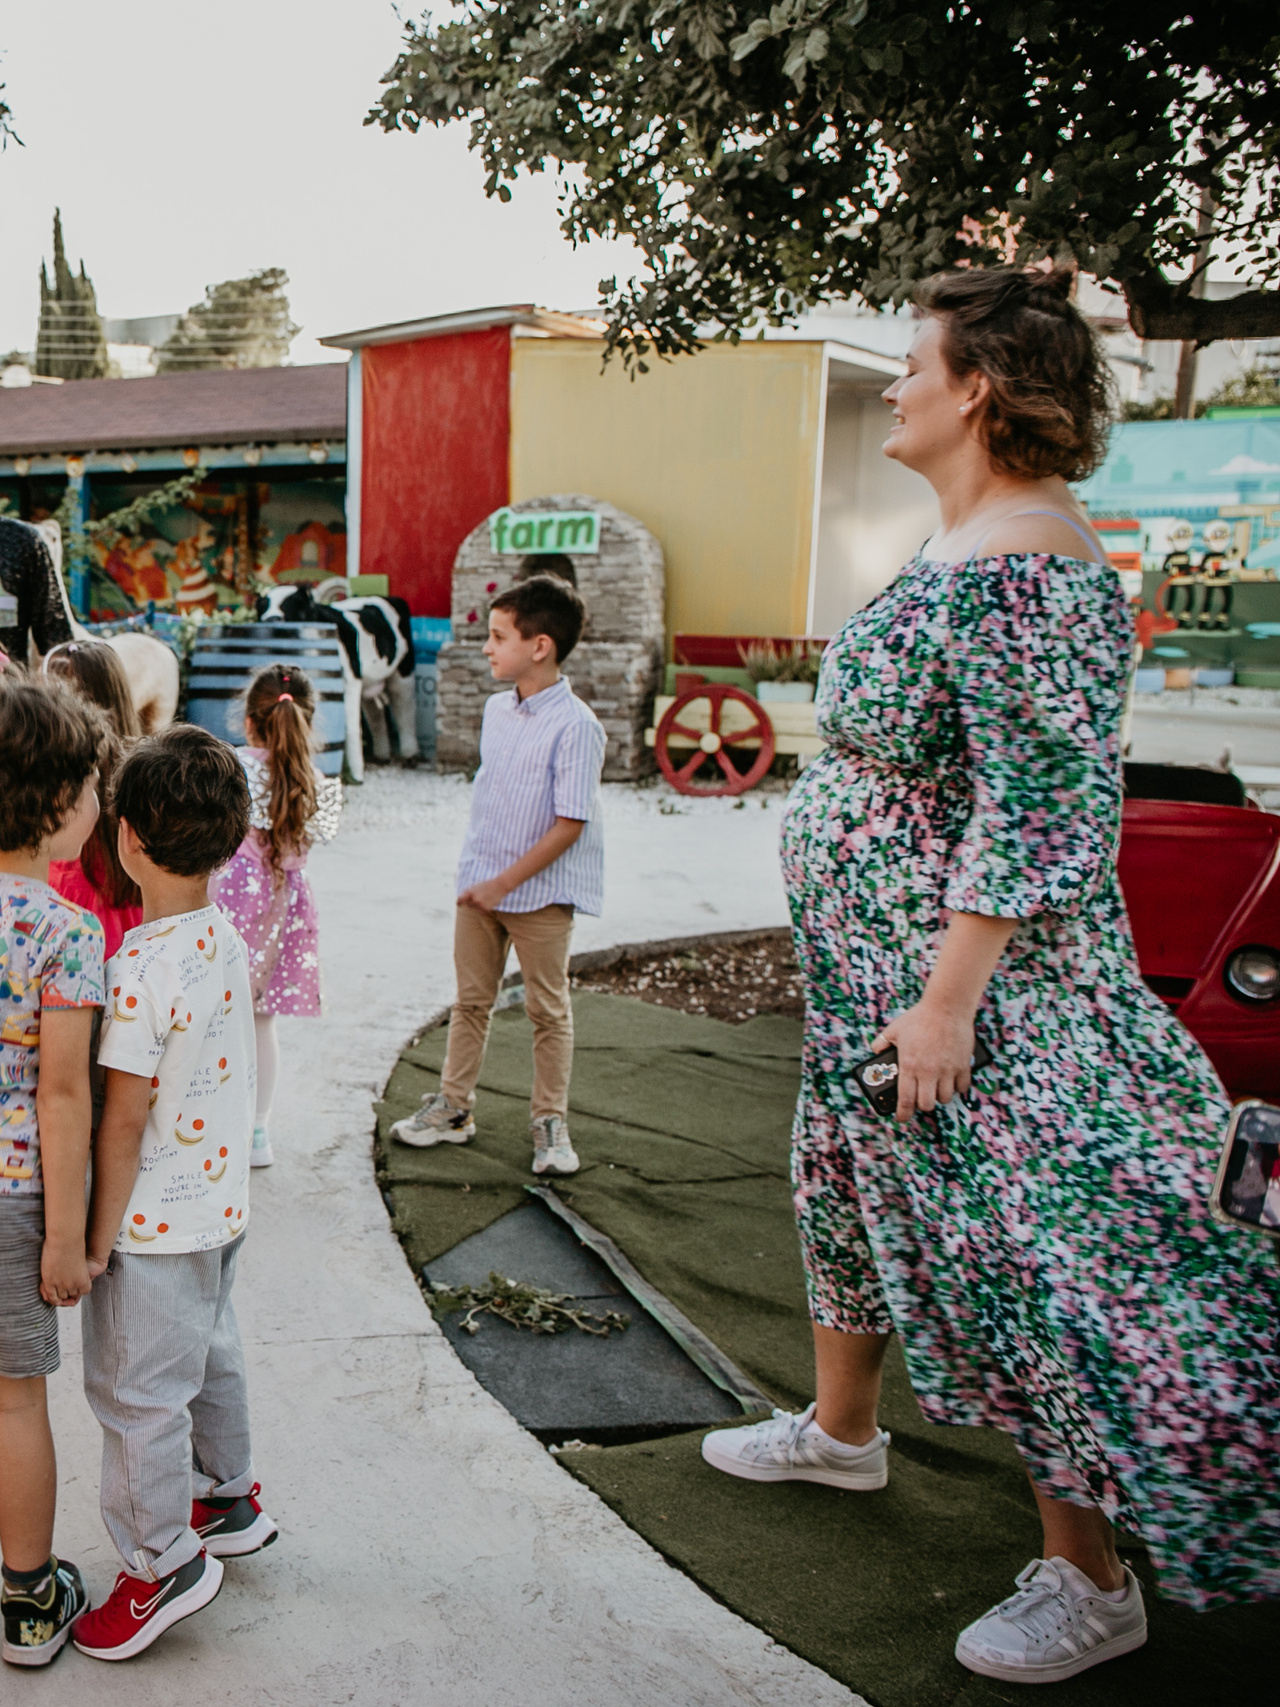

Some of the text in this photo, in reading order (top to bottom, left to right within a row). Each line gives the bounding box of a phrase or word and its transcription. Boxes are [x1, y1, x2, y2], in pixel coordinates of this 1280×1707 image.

[494, 513, 594, 552] farm
[194, 1067, 211, 1076] ILE
[171, 1171, 202, 1184] SMILE
